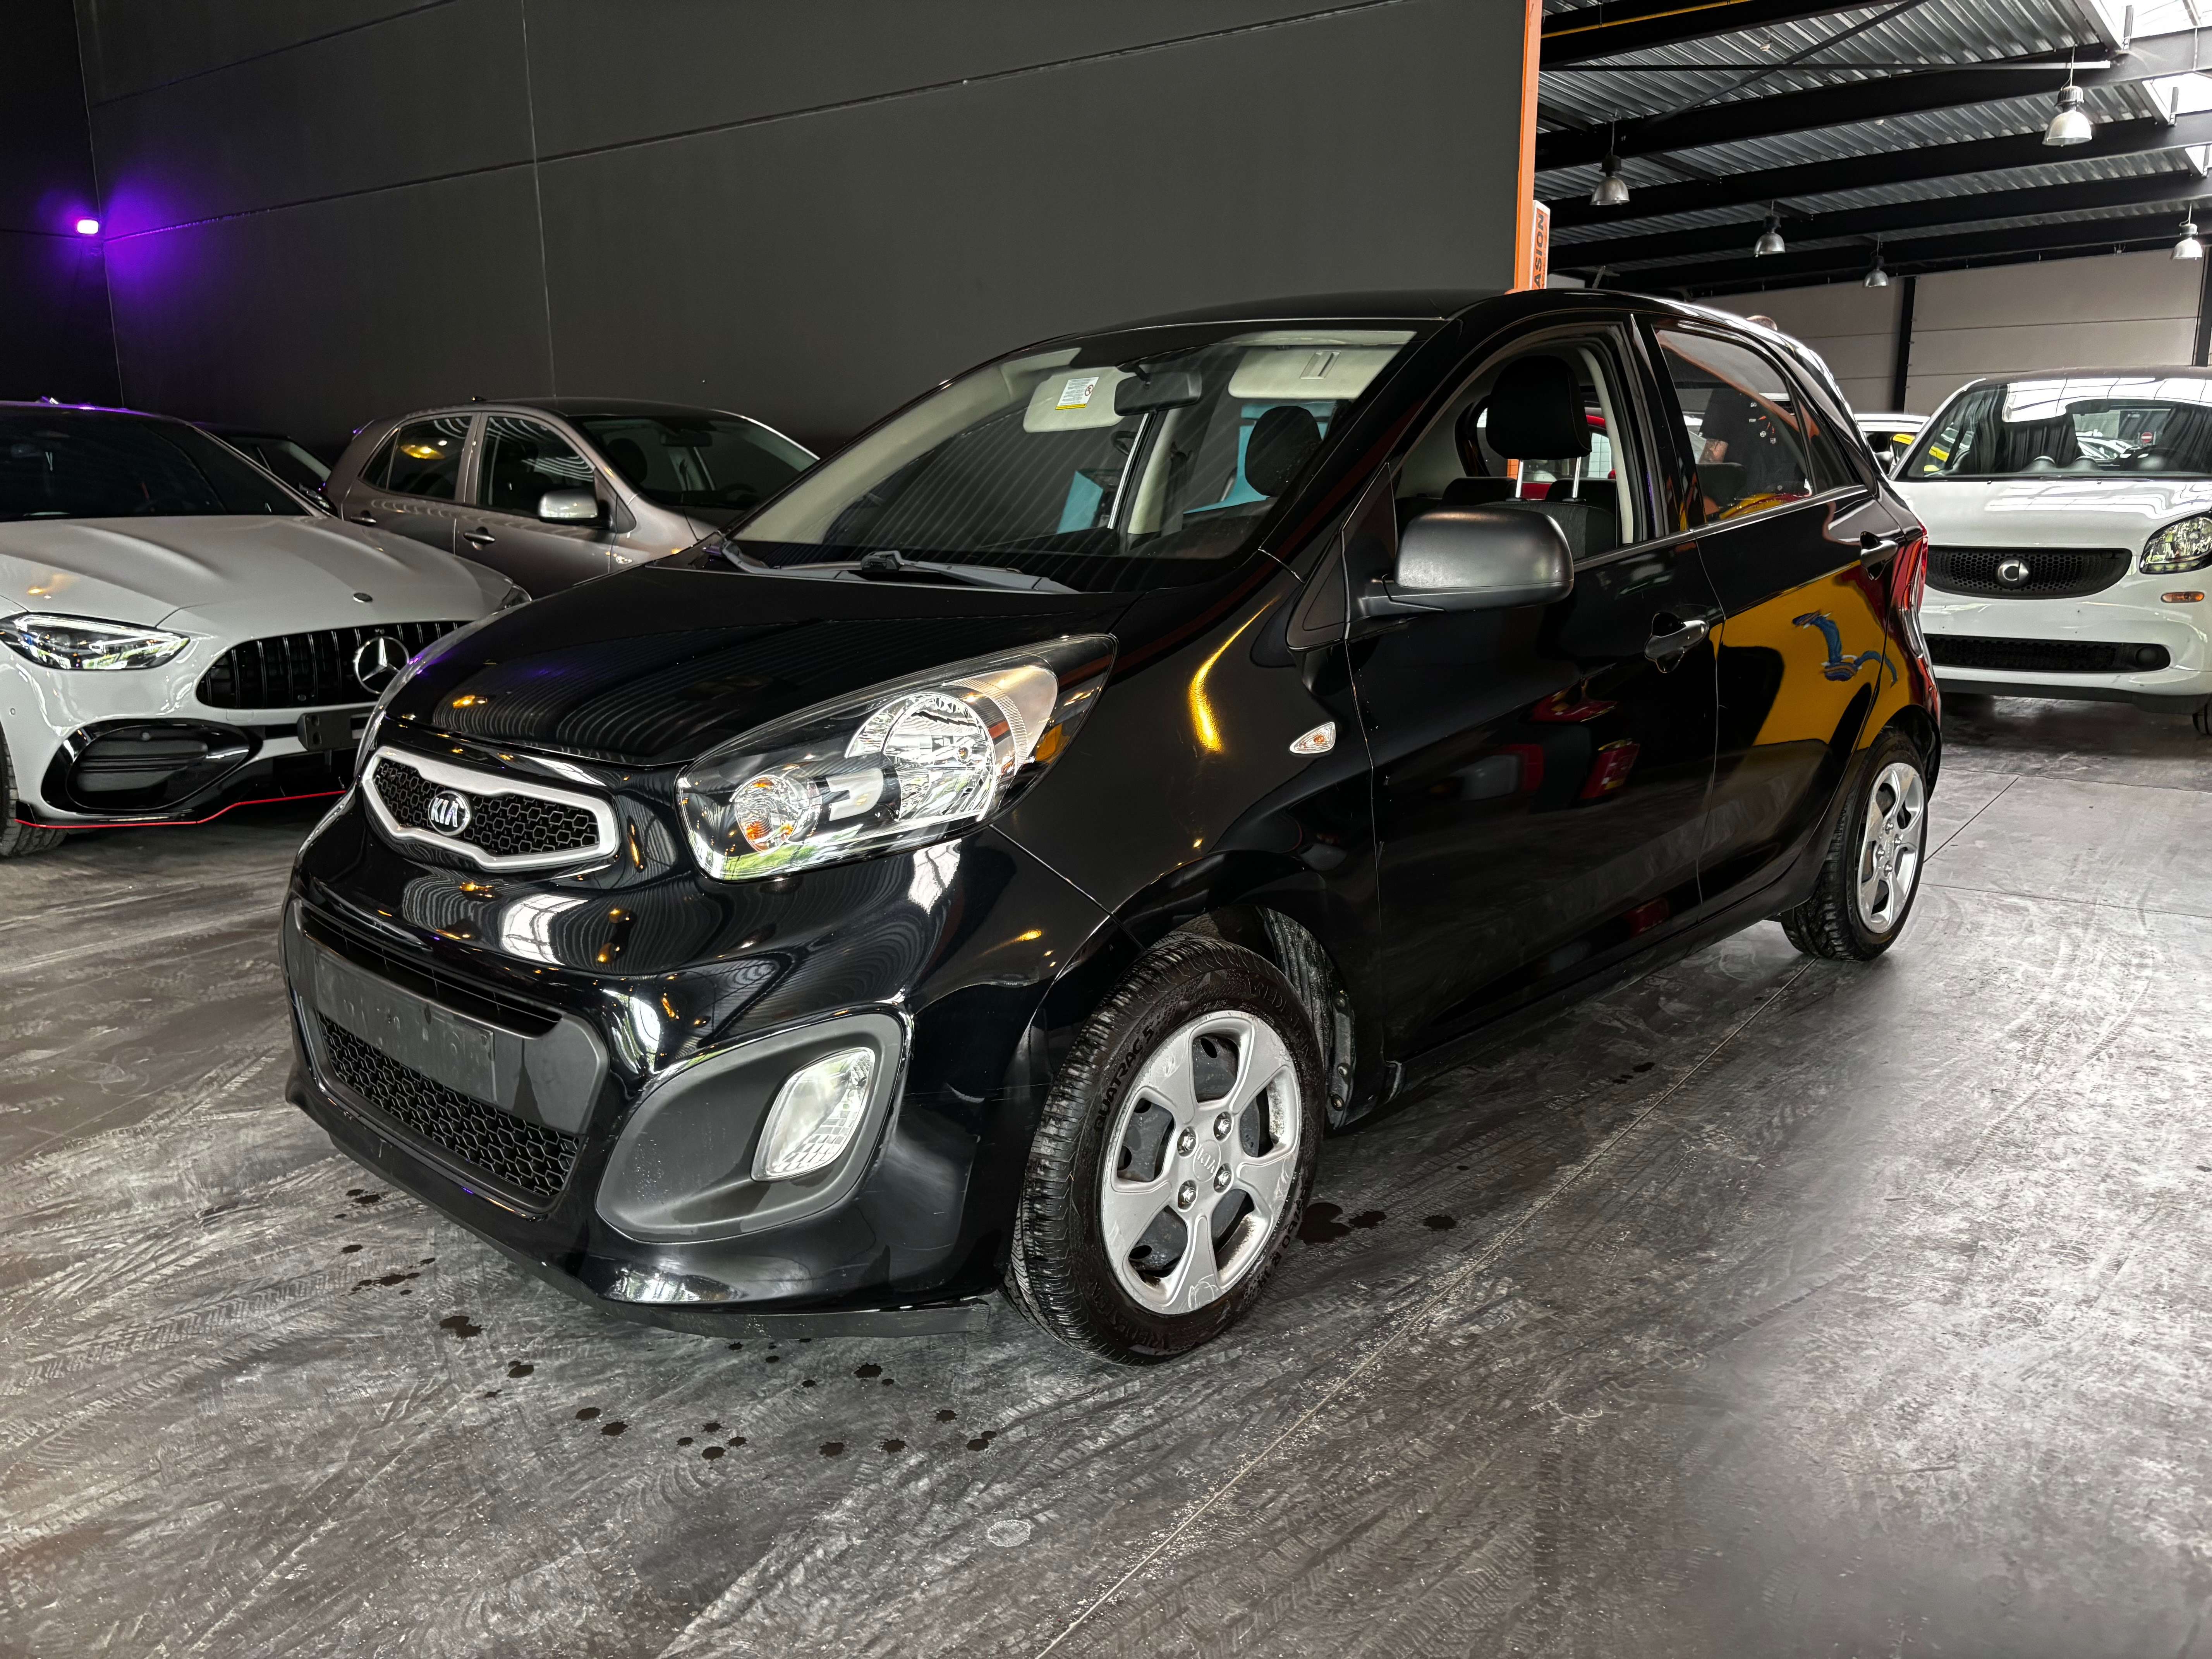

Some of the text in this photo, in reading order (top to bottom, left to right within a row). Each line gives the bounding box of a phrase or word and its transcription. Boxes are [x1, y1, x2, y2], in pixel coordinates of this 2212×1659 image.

[431, 797, 459, 827] KIA
[1094, 1025, 1154, 1131] QUATRAC 5
[1197, 1148, 1215, 1173] KIA
